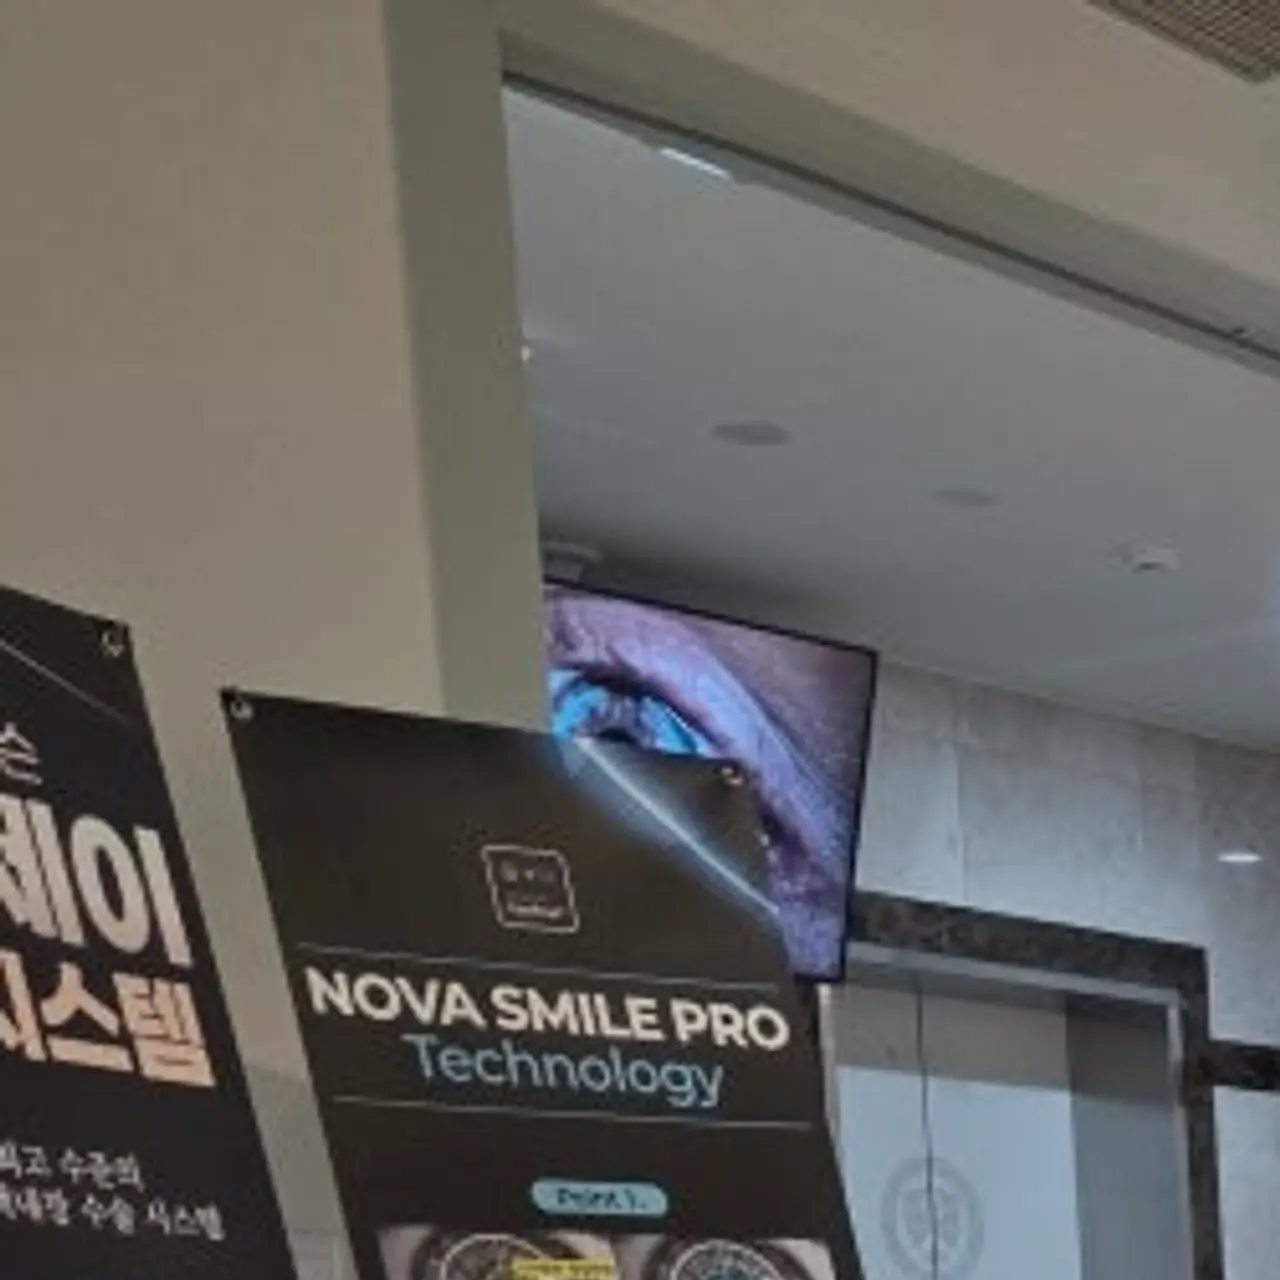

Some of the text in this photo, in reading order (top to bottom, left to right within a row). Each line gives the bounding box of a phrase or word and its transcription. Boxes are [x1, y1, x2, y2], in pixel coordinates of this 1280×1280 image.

[305, 965, 791, 1051] NOVA SMILE PRO
[403, 1032, 724, 1107] Technology
